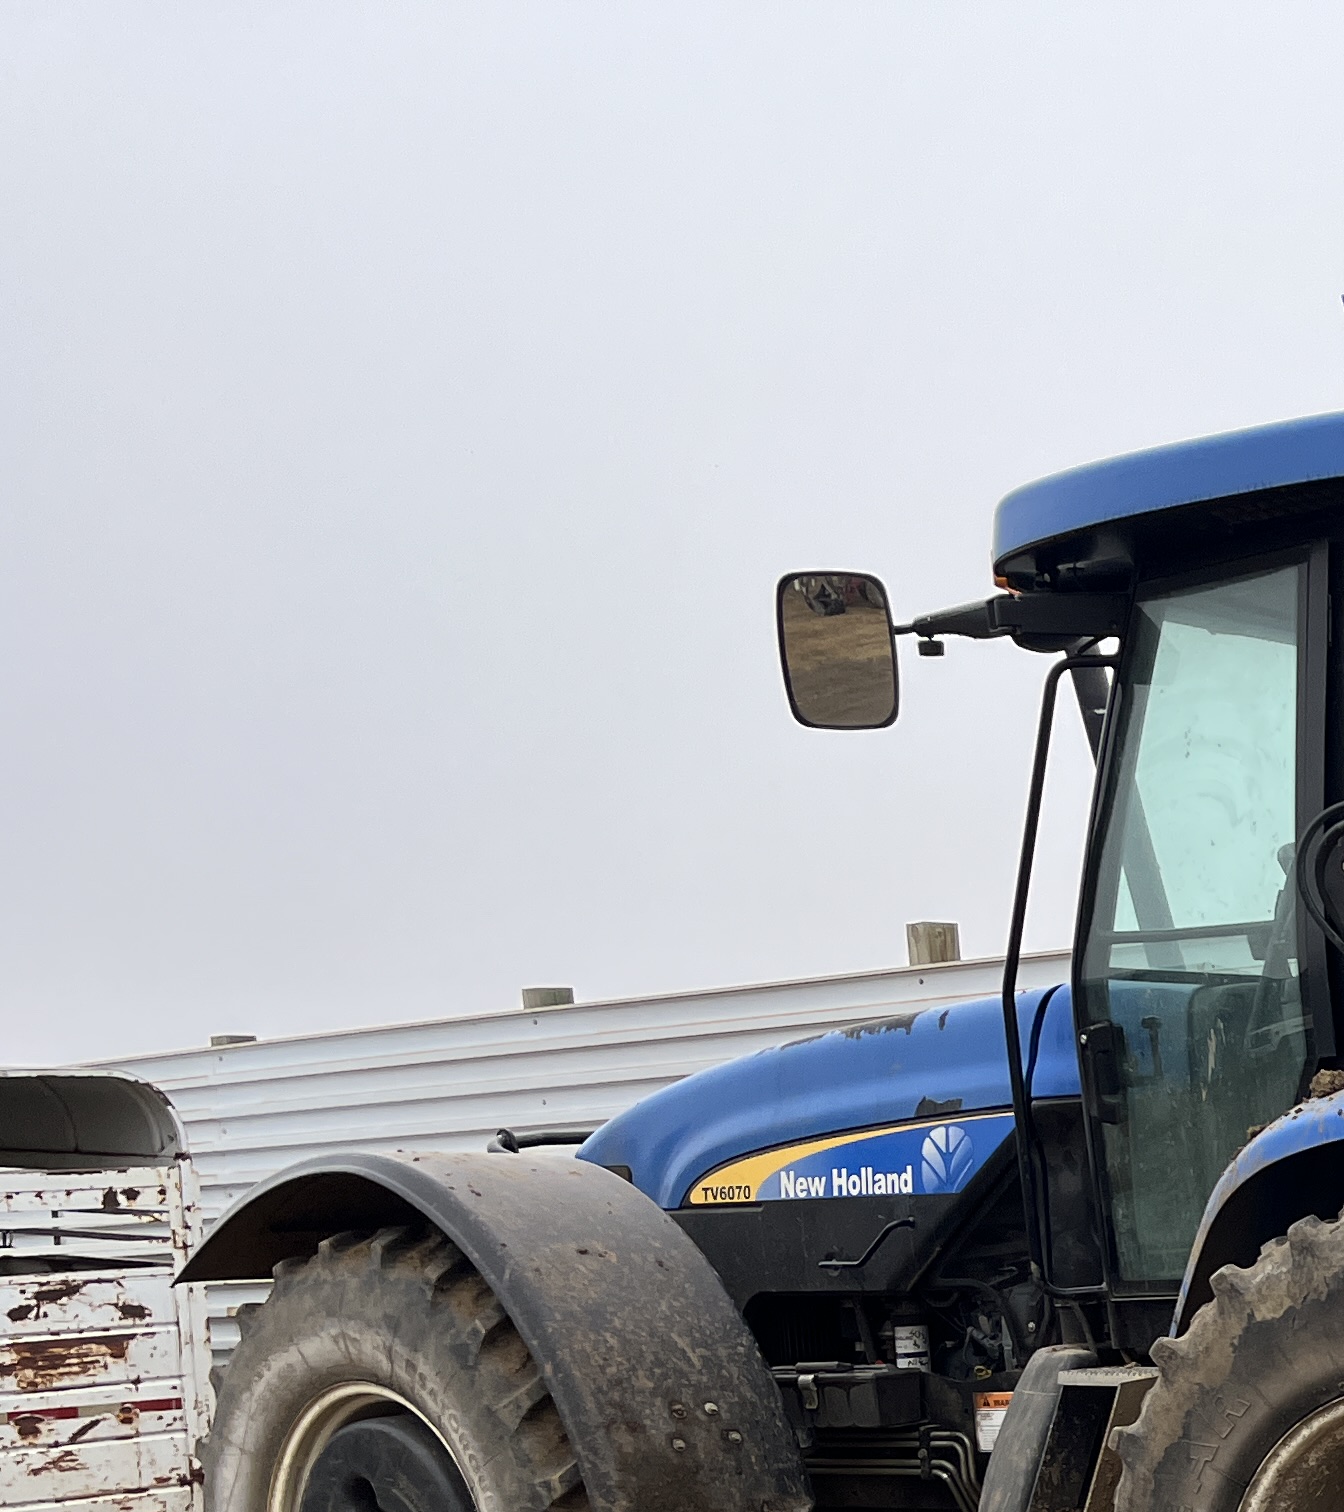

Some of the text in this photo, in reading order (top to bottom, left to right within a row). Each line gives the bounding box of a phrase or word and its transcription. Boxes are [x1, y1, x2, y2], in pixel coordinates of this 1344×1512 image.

[701, 1185, 751, 1202] TV6070
[779, 1164, 914, 1200] New Holland
